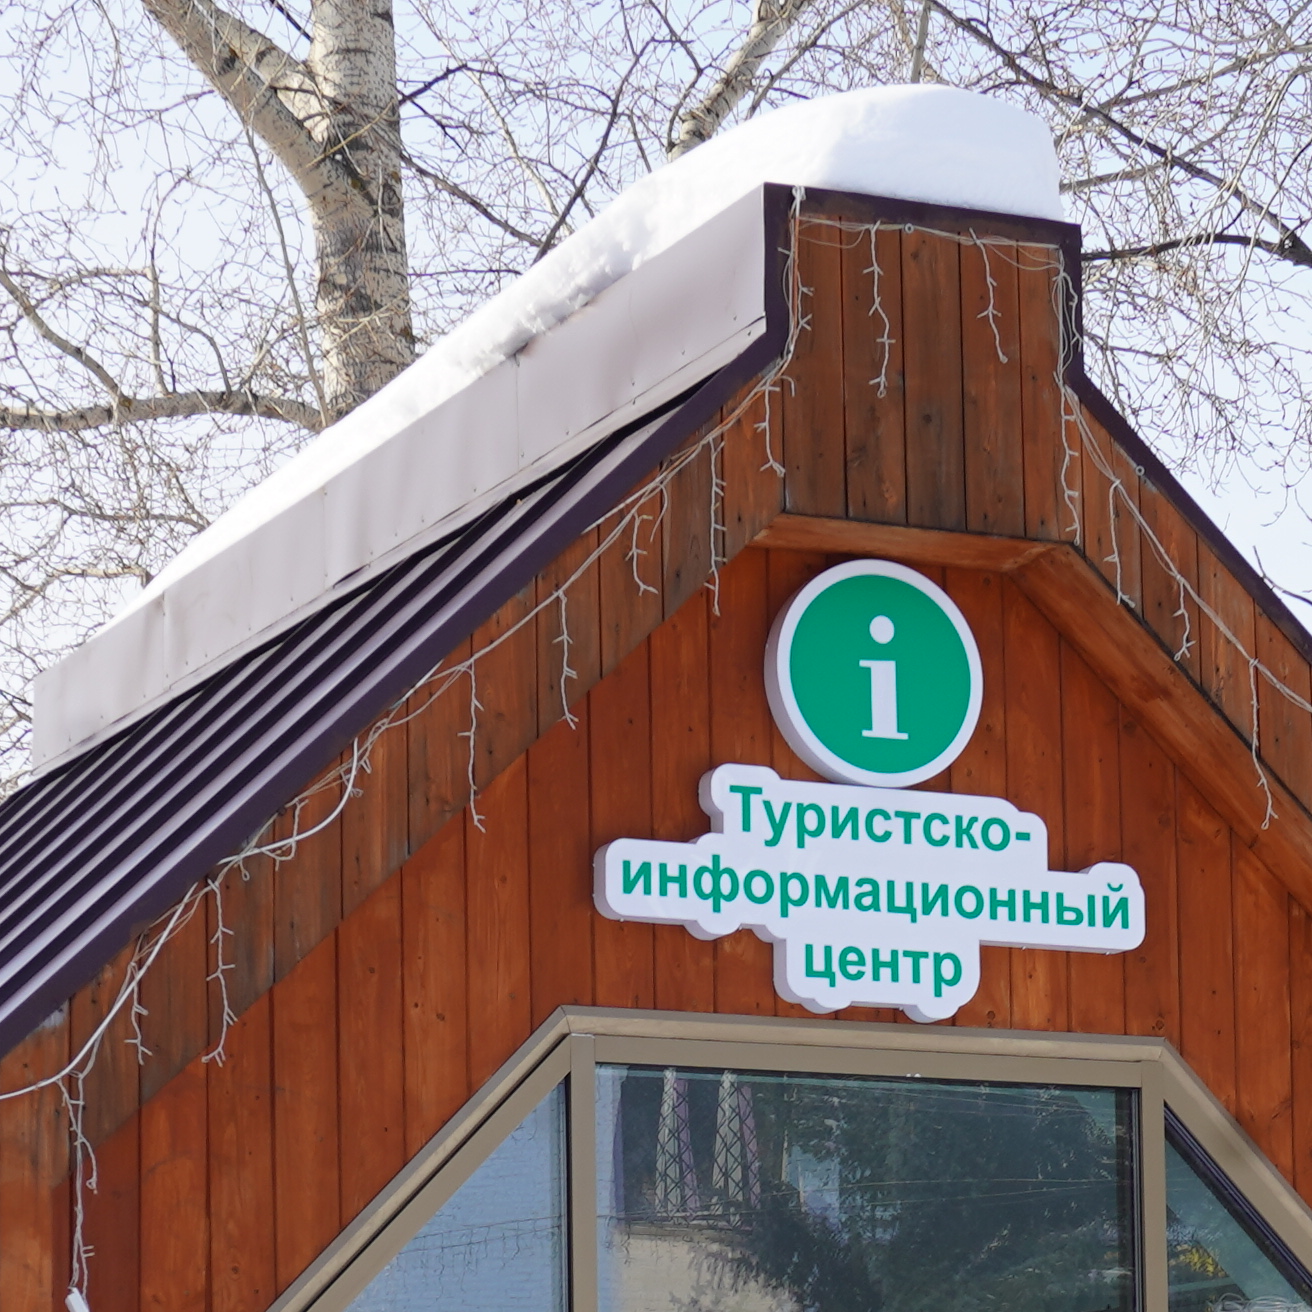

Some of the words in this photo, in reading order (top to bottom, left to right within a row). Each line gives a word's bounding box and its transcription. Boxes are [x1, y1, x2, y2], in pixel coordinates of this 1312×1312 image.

[859, 615, 908, 740] i
[729, 785, 1031, 852] Туристско-
[621, 855, 1130, 930] информационный
[804, 943, 963, 997] центр
